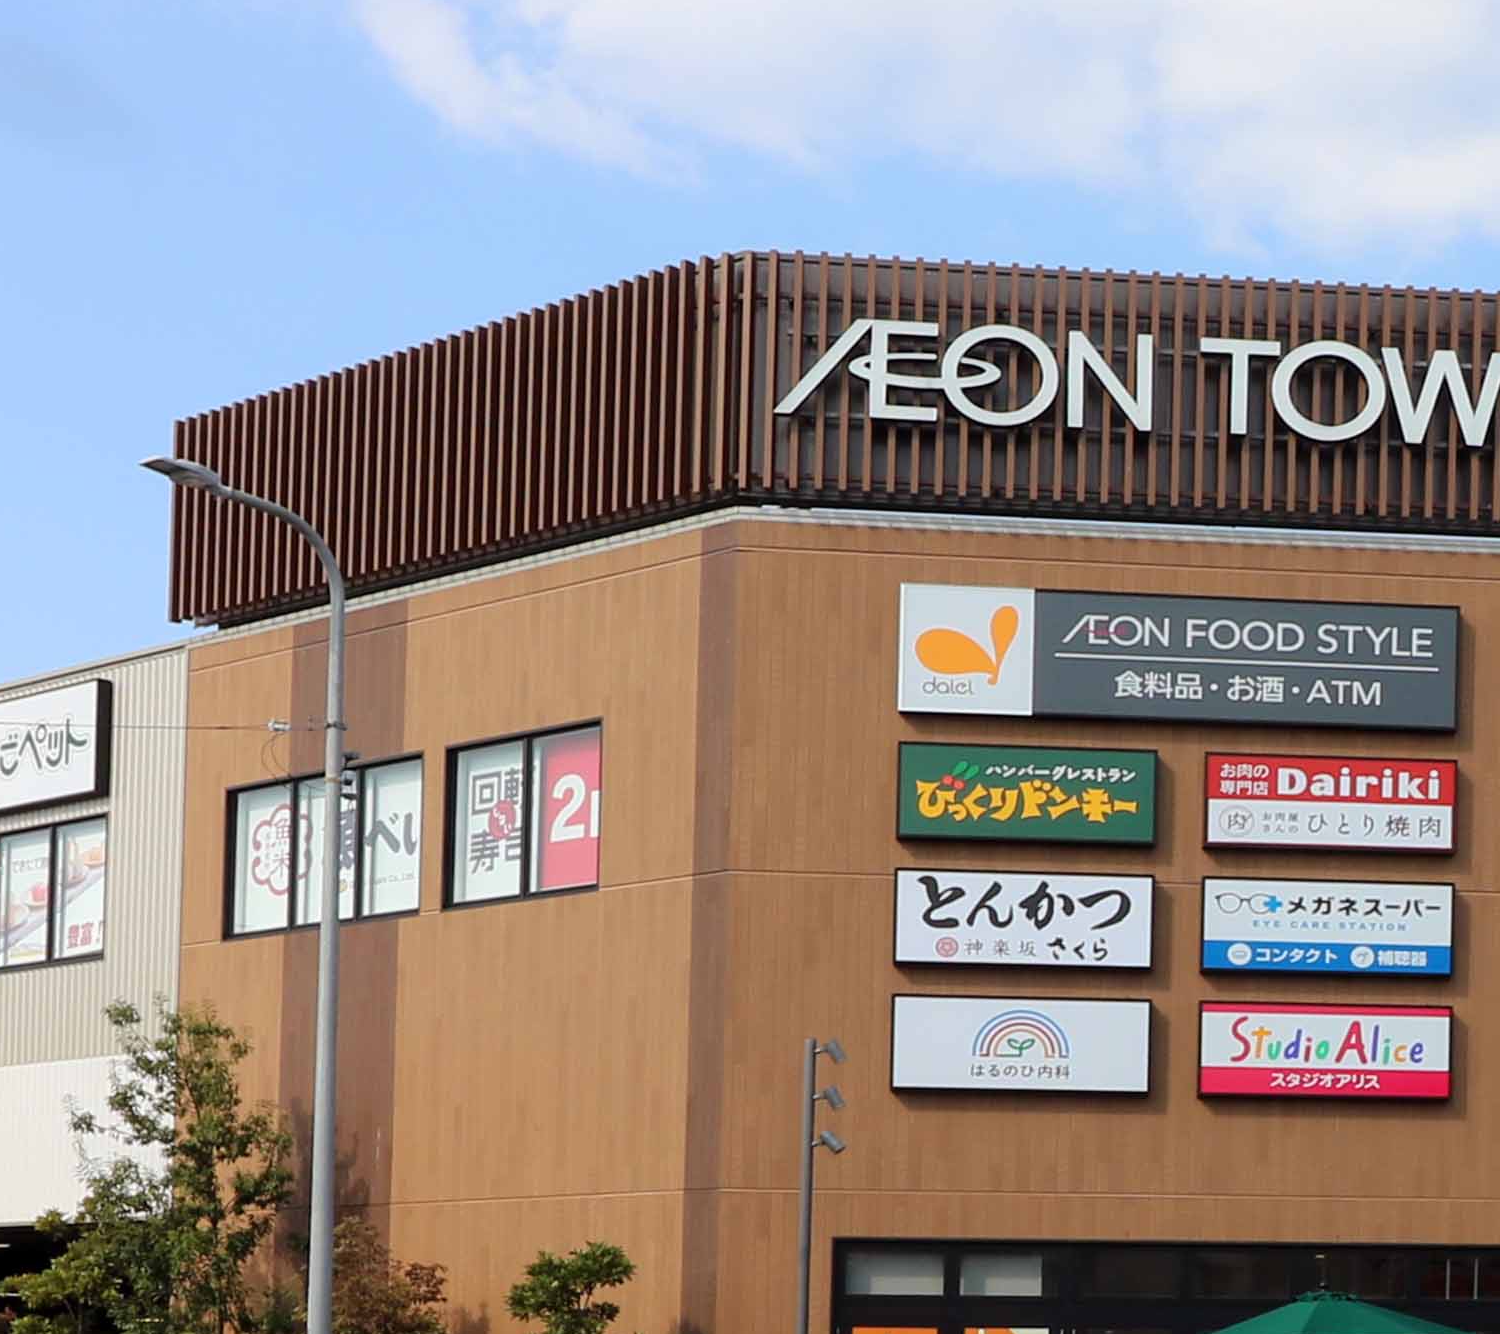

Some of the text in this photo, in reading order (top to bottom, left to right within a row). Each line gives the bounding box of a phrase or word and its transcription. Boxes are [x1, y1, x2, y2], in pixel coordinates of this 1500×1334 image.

[1186, 618, 1305, 653] FOOD
[1316, 623, 1434, 658] STYLE
[985, 764, 1137, 783] ハンバーグレストラン
[1219, 763, 1270, 779] お肉の
[1219, 780, 1269, 796] 専門店
[1276, 766, 1440, 800] Dairiki
[915, 779, 1140, 823] びっくりドンキー
[1307, 814, 1442, 839] ひとり焼肉
[916, 875, 1132, 931] とんかつ
[1286, 896, 1442, 917] メガネスーパー
[1252, 919, 1408, 932] EYE CARE STATION
[963, 937, 1109, 961] 神楽坂 さくら
[1255, 947, 1428, 967] コンタクト 補聴器
[1230, 1015, 1425, 1065] Studio Alice
[969, 1063, 1071, 1079] はるのひ内科
[1269, 1072, 1381, 1089] スタジオアリス
